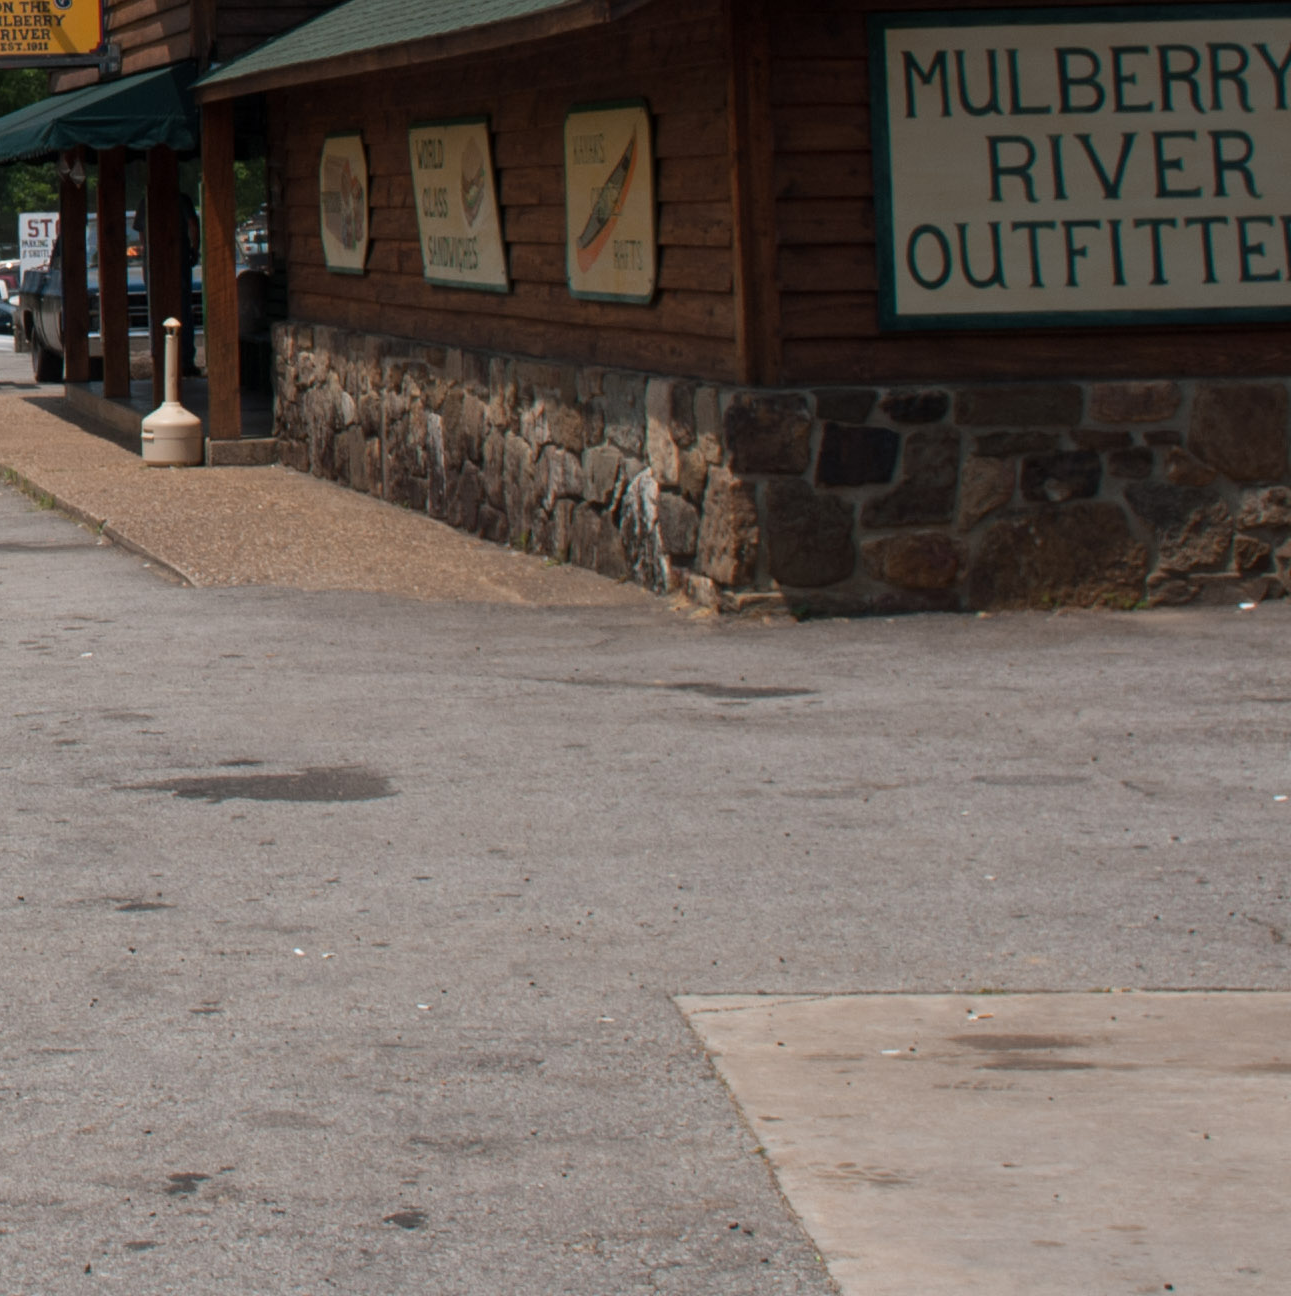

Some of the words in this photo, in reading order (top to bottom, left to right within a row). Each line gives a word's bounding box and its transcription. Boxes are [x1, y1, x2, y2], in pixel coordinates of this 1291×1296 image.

[19, 1, 51, 13] THE
[0, 29, 51, 41] RIVER
[903, 42, 1291, 119] MULBERRY
[415, 138, 444, 170] WORLD
[986, 130, 1263, 202] RIVER
[423, 187, 449, 218] CLASS
